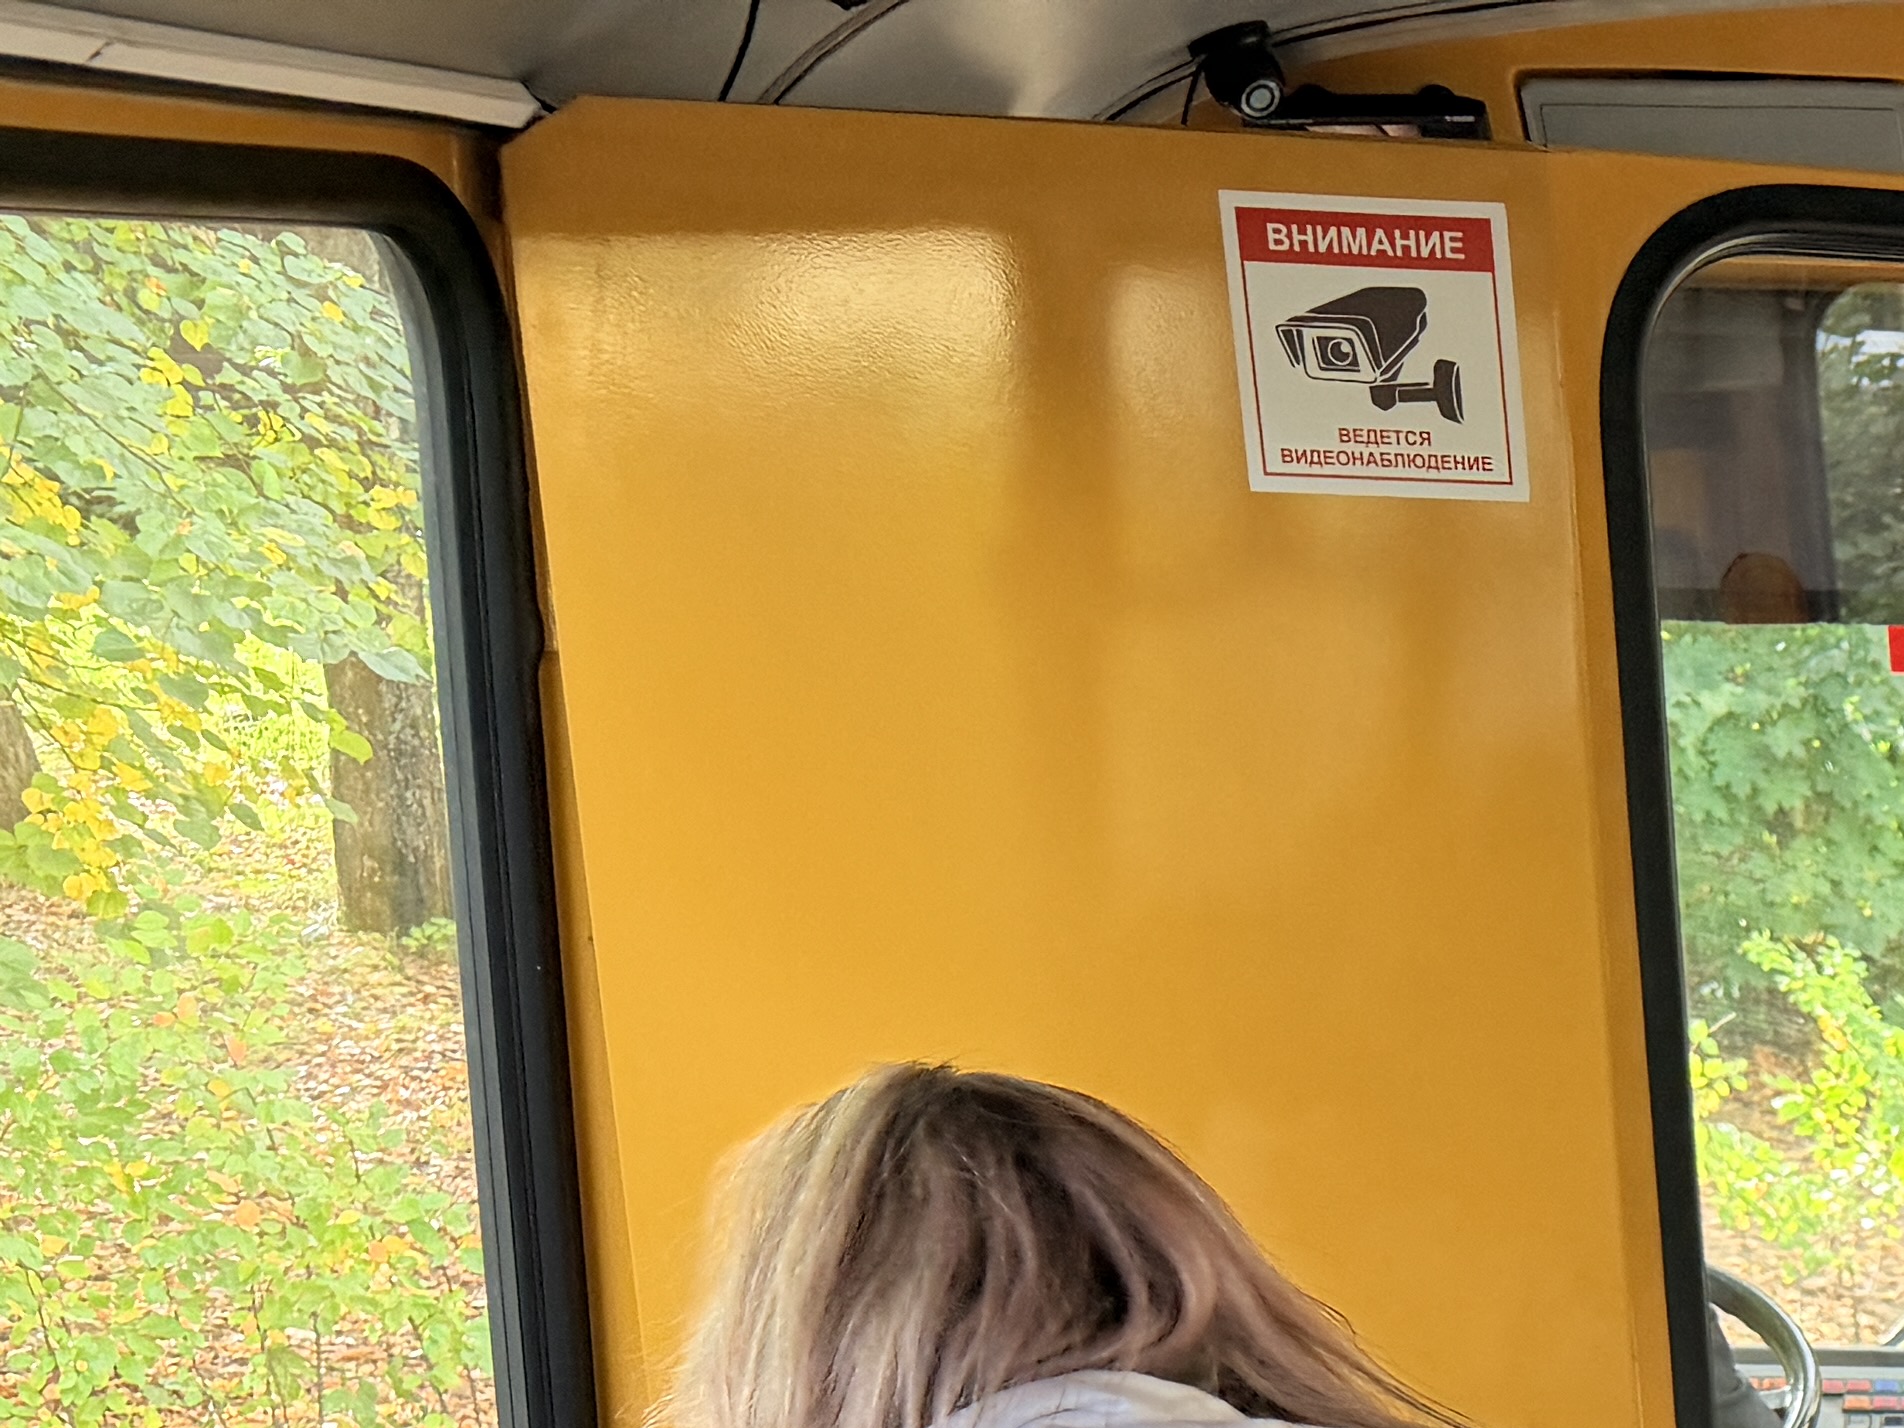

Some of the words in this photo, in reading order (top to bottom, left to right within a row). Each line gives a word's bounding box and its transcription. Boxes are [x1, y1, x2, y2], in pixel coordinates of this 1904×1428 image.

[1266, 222, 1466, 260] ВНИМАНИЕ
[1338, 427, 1432, 448] ВЕДЕТСЯ
[1280, 447, 1494, 473] ВИДЕОНАБЛЮДЕНИЕ
